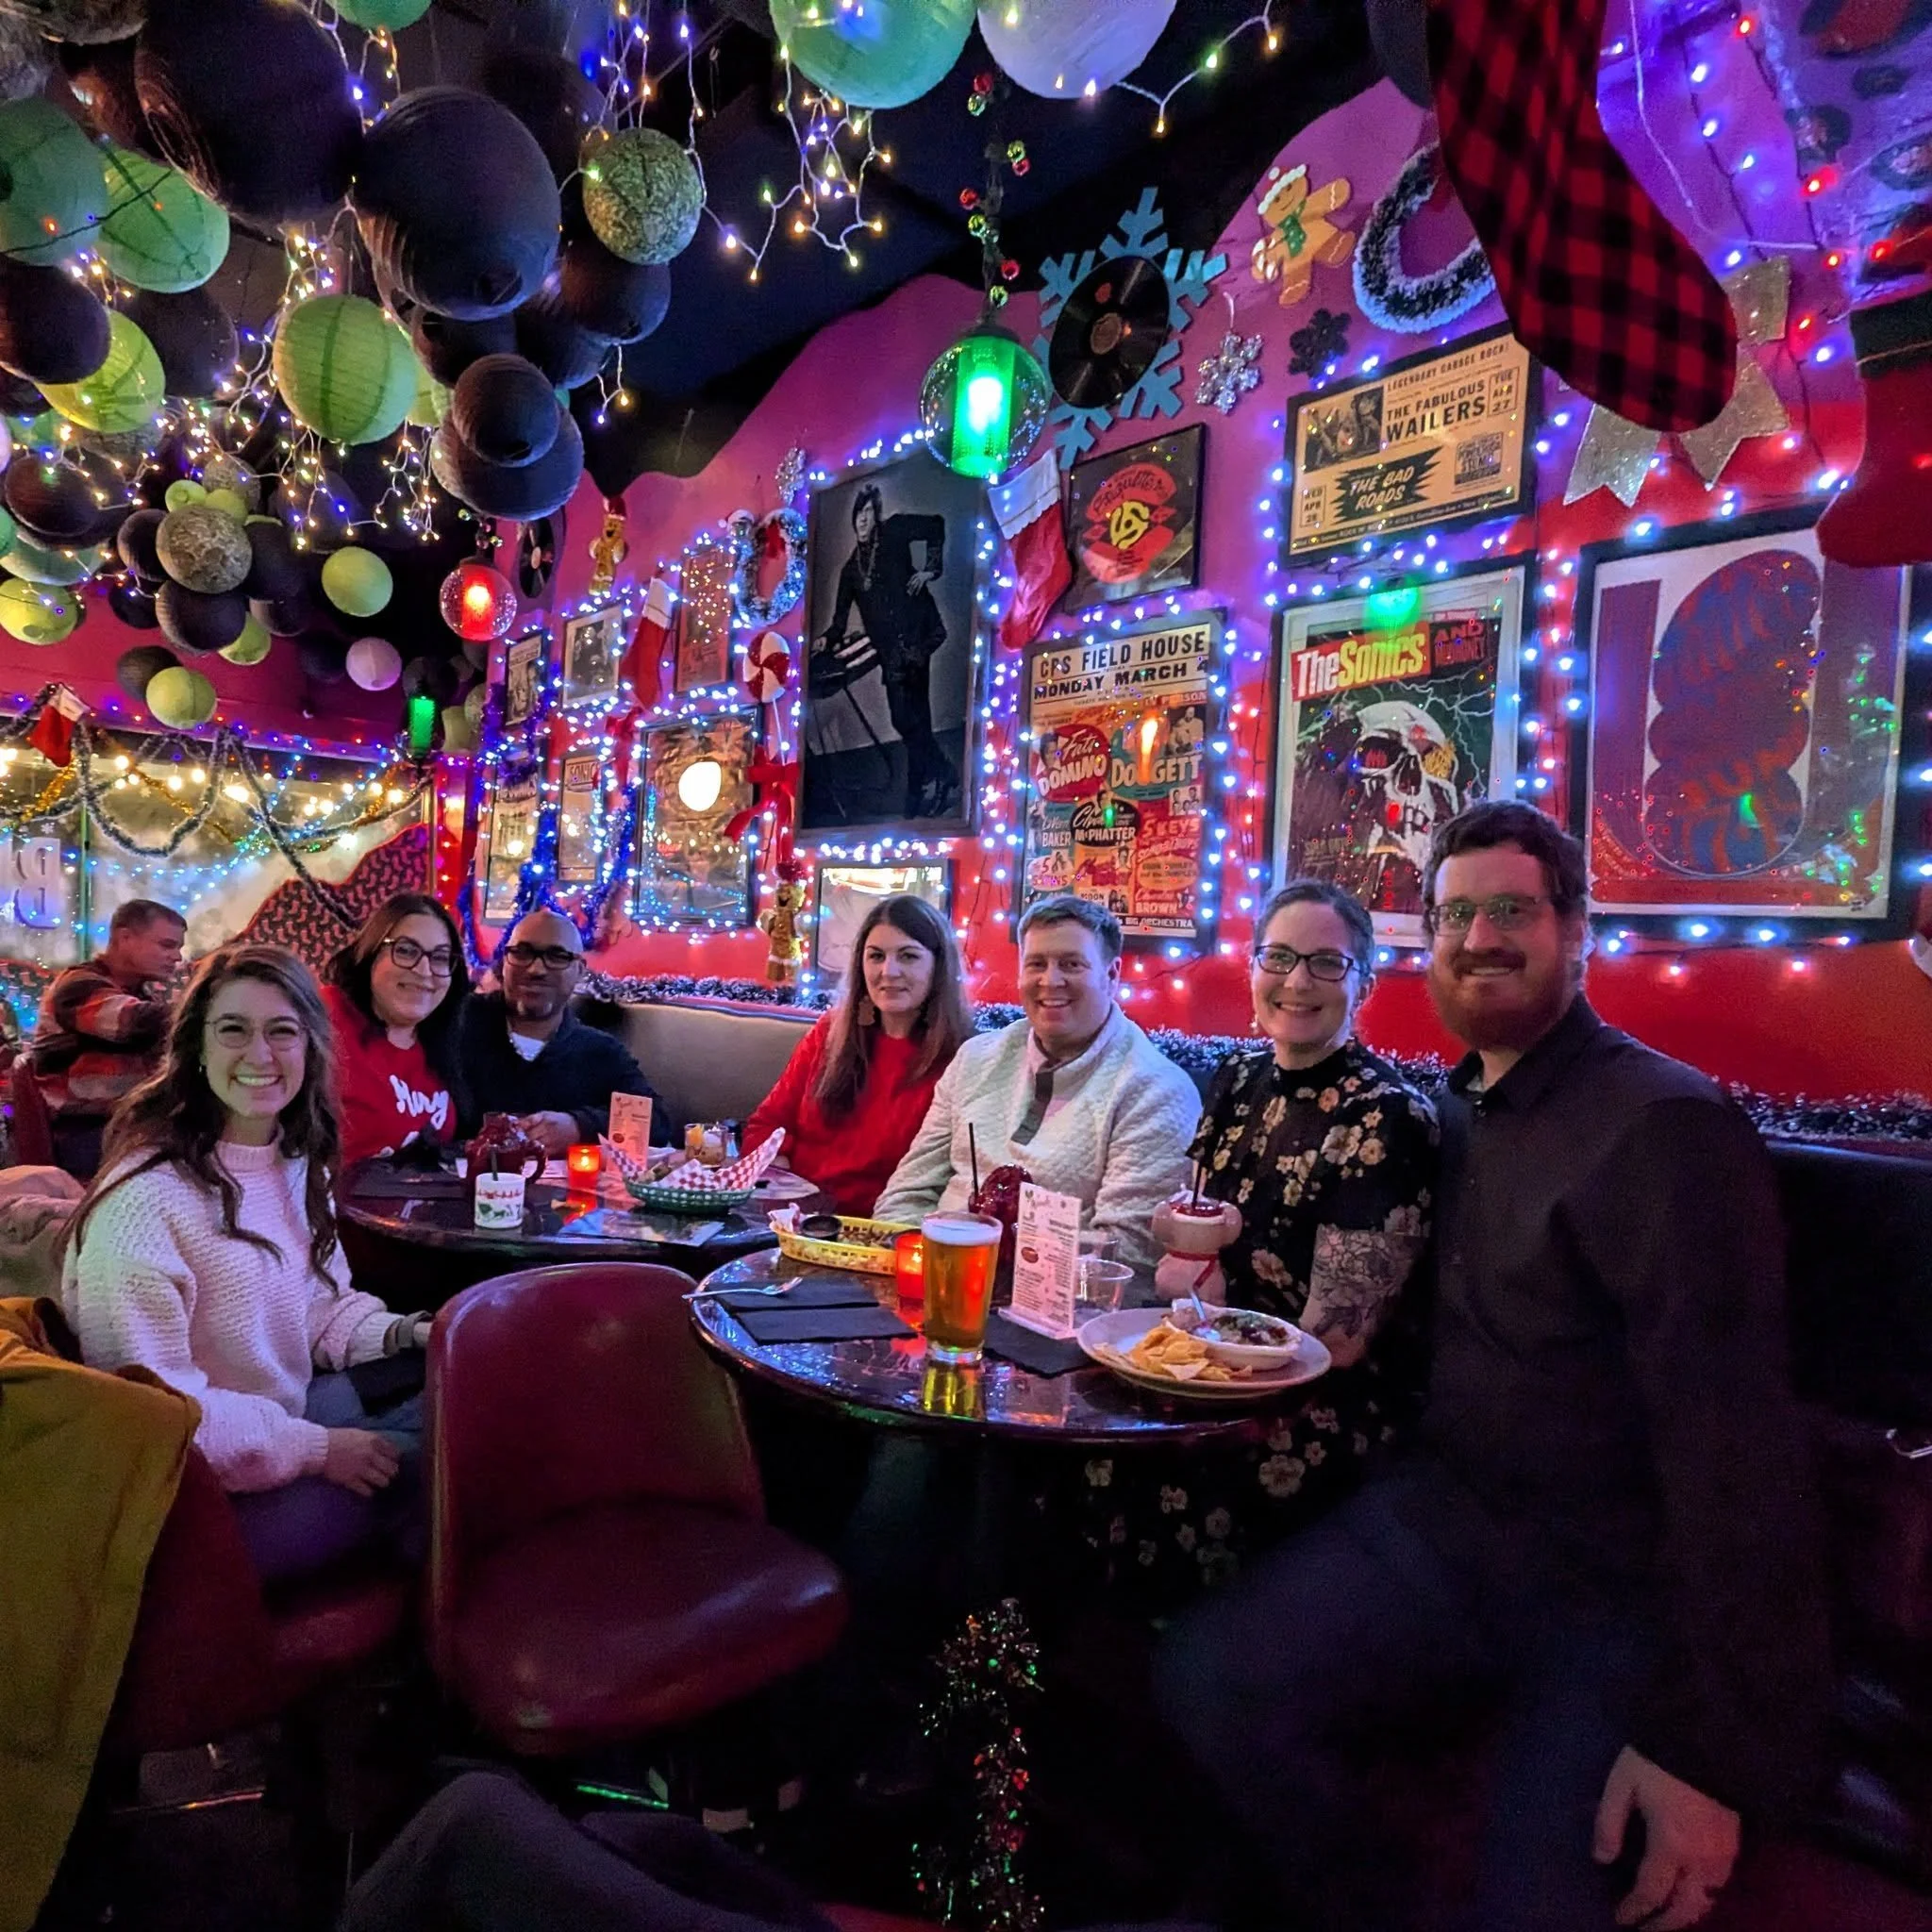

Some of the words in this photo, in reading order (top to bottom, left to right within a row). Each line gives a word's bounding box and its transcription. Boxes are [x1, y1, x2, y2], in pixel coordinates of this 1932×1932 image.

[1388, 367, 1437, 391] LEGENDARY
[1387, 404, 1411, 422] THE
[1416, 379, 1486, 413] FABULOUS
[1492, 399, 1510, 413] 27
[1386, 396, 1486, 442] WAILERS
[1350, 475, 1380, 496] THE
[1382, 465, 1415, 488] BAD
[1355, 484, 1407, 511] ROADS
[1040, 655, 1072, 678] CPS
[1081, 643, 1131, 672] FIELD
[1141, 630, 1206, 662] HOUSE
[1034, 675, 1106, 701] MONDAY
[1115, 662, 1188, 687] MARCH
[1160, 691, 1208, 706] PSON
[1038, 754, 1107, 796] DOMINO
[1111, 754, 1204, 788] DOGETT
[1042, 831, 1072, 847] BAKER
[1135, 902, 1178, 914] BROWN
[1141, 918, 1194, 928] ORCHESTRA
